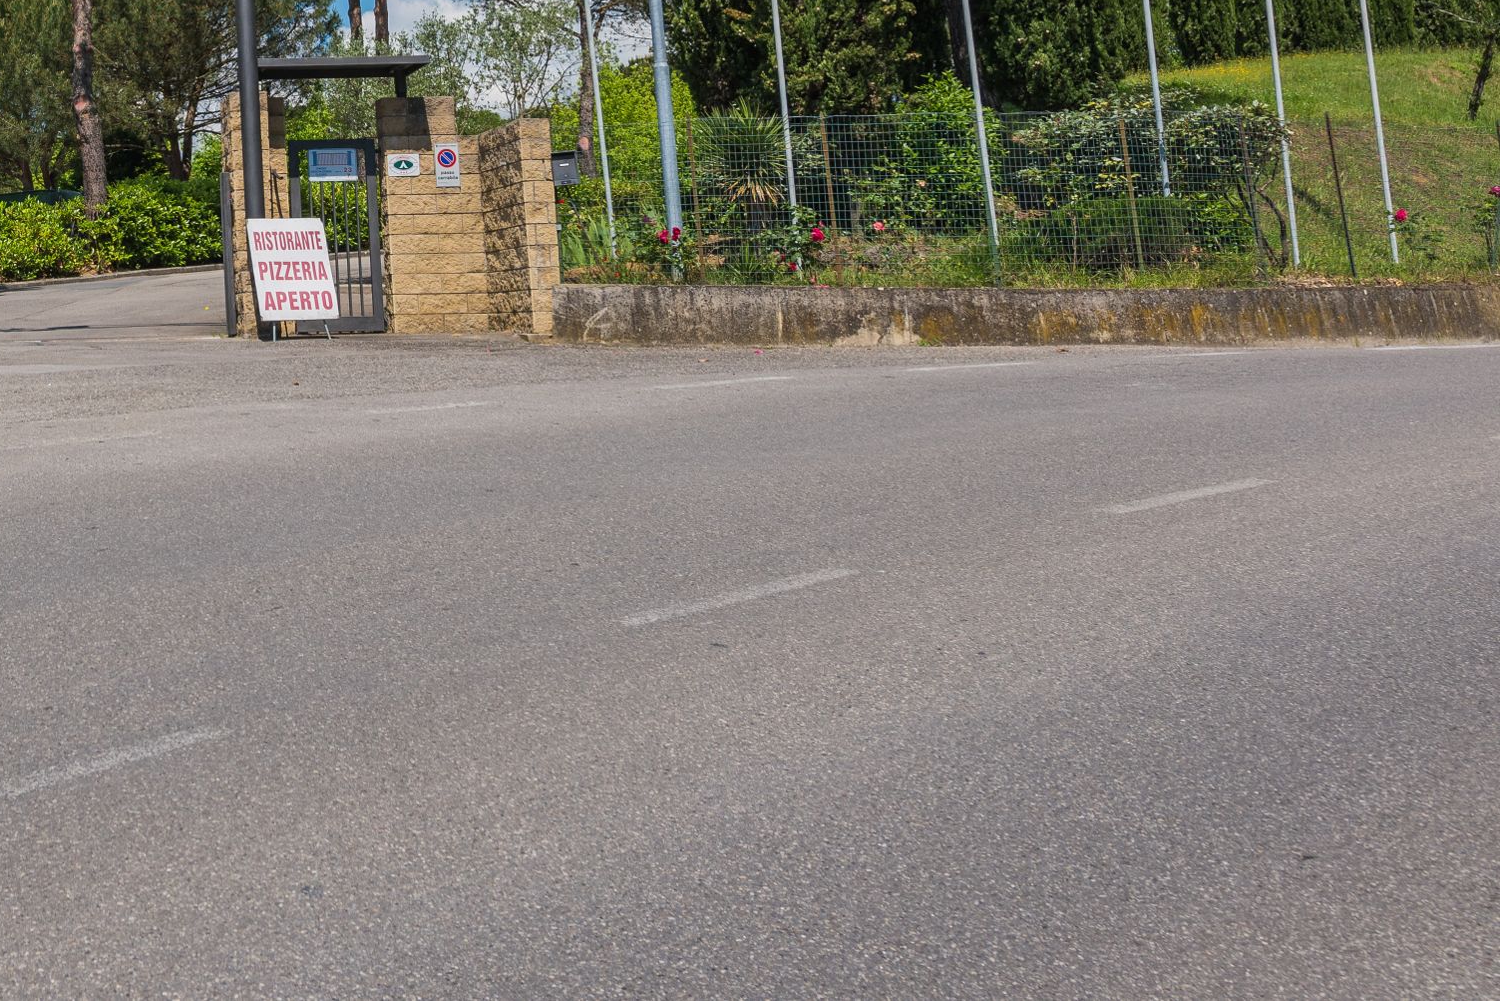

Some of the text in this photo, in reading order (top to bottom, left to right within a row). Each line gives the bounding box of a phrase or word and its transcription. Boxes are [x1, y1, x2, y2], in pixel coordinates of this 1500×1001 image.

[253, 230, 323, 251] RISTORANTE
[258, 261, 328, 281] PIZZERIA
[264, 290, 334, 311] APERTO
